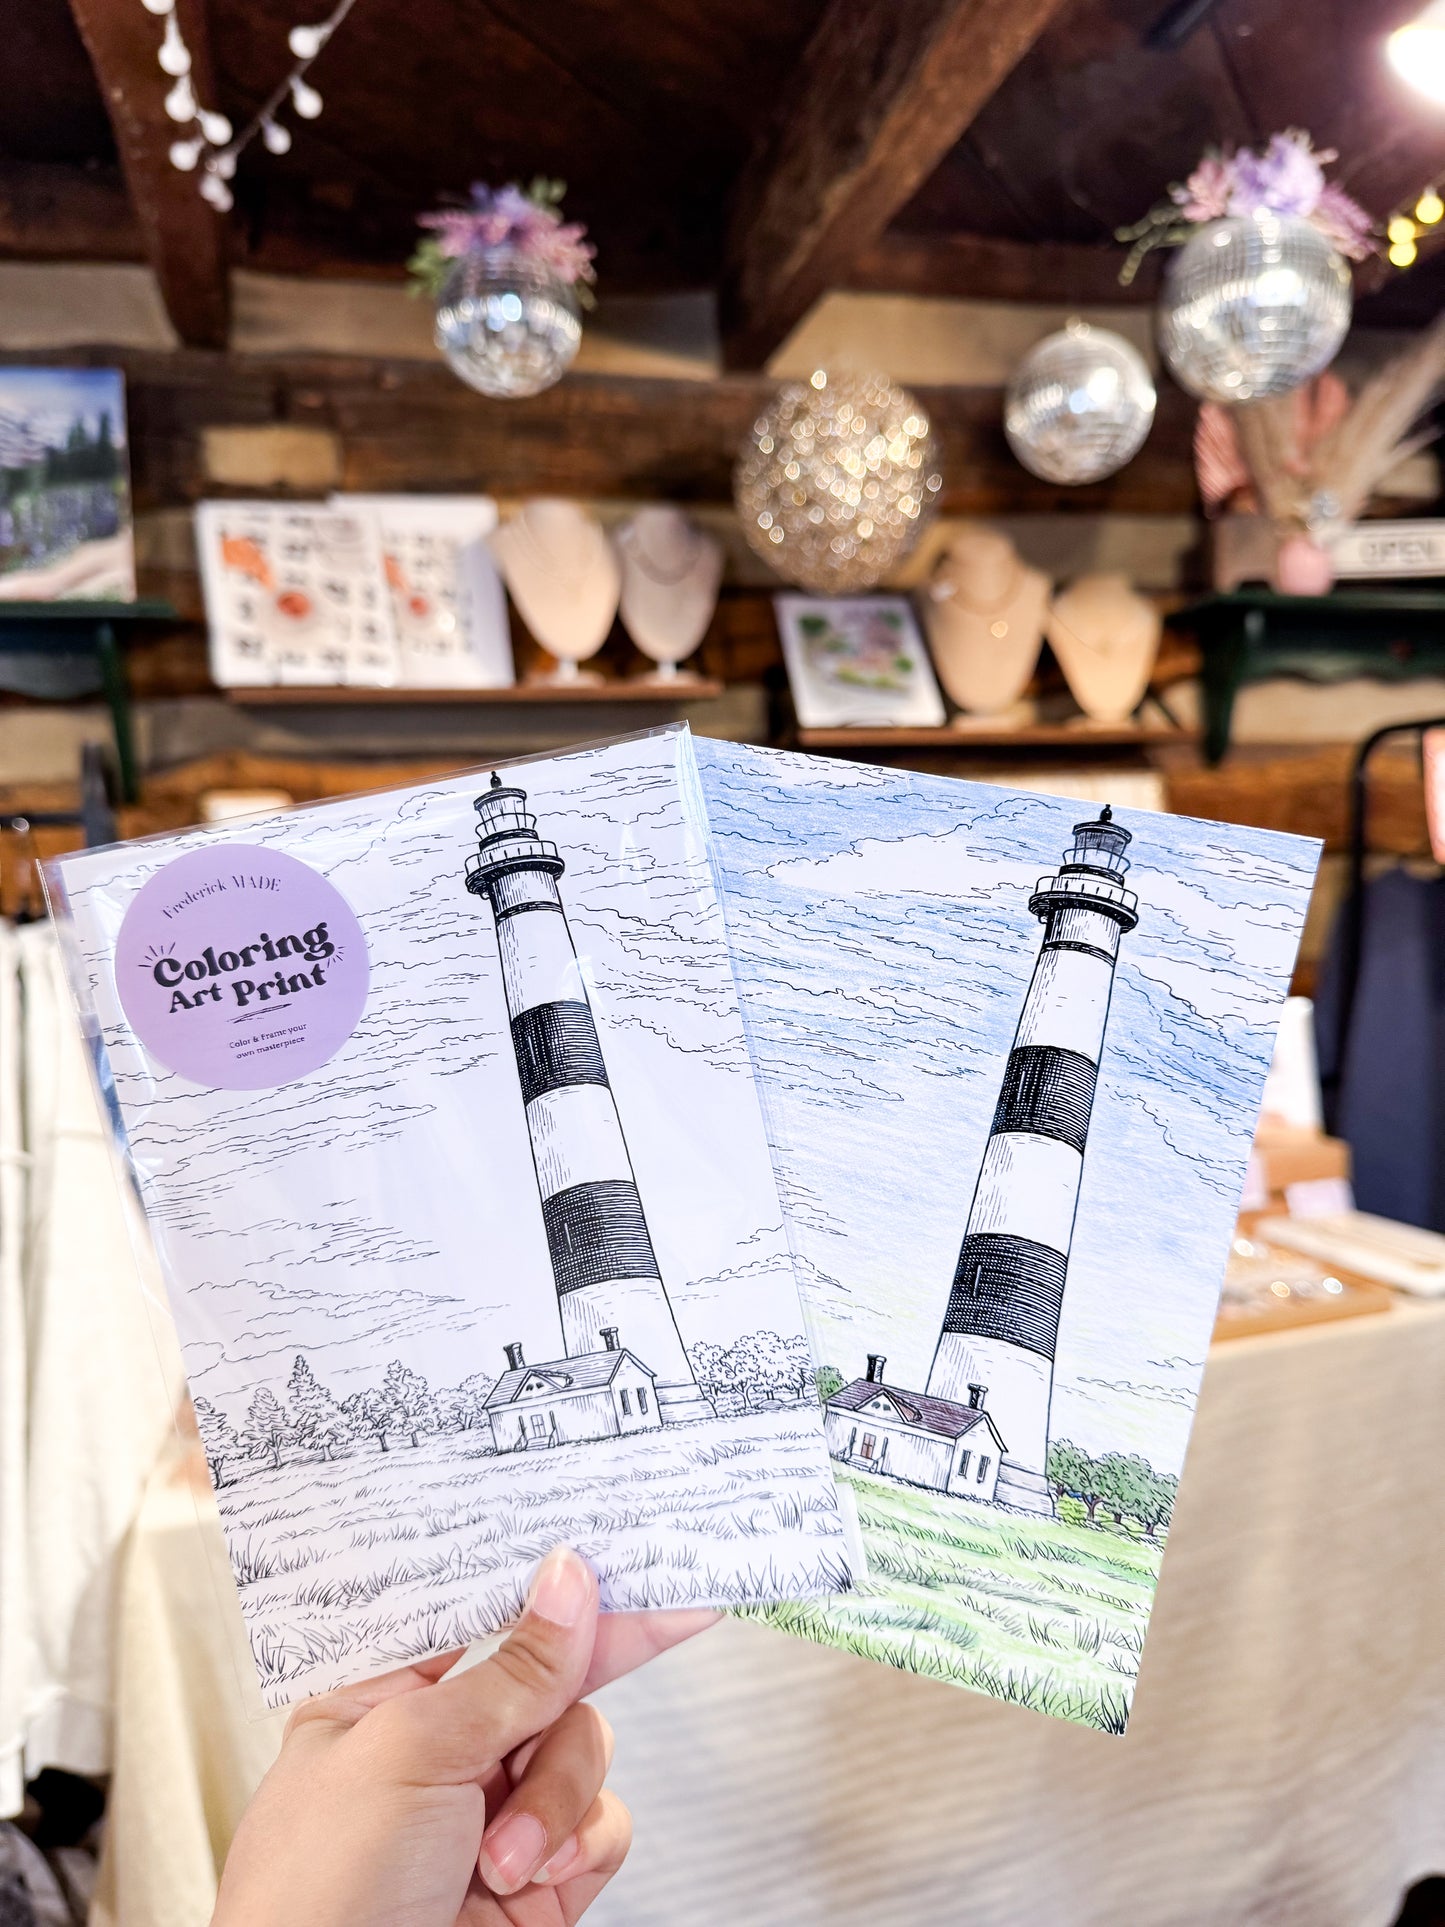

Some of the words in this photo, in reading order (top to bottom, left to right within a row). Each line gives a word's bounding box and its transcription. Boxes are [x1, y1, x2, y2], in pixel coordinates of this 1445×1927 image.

[162, 878, 227, 919] Frederick
[232, 874, 282, 892] MADE
[153, 922, 335, 988] Coloring
[169, 982, 223, 1013] Art
[231, 963, 327, 1007] Print
[229, 1038, 251, 1049] Color
[253, 1035, 259, 1043] &
[261, 1029, 287, 1041] Frame
[288, 1023, 307, 1035] your
[236, 1049, 255, 1059] own
[256, 1036, 305, 1054] masterpiece
